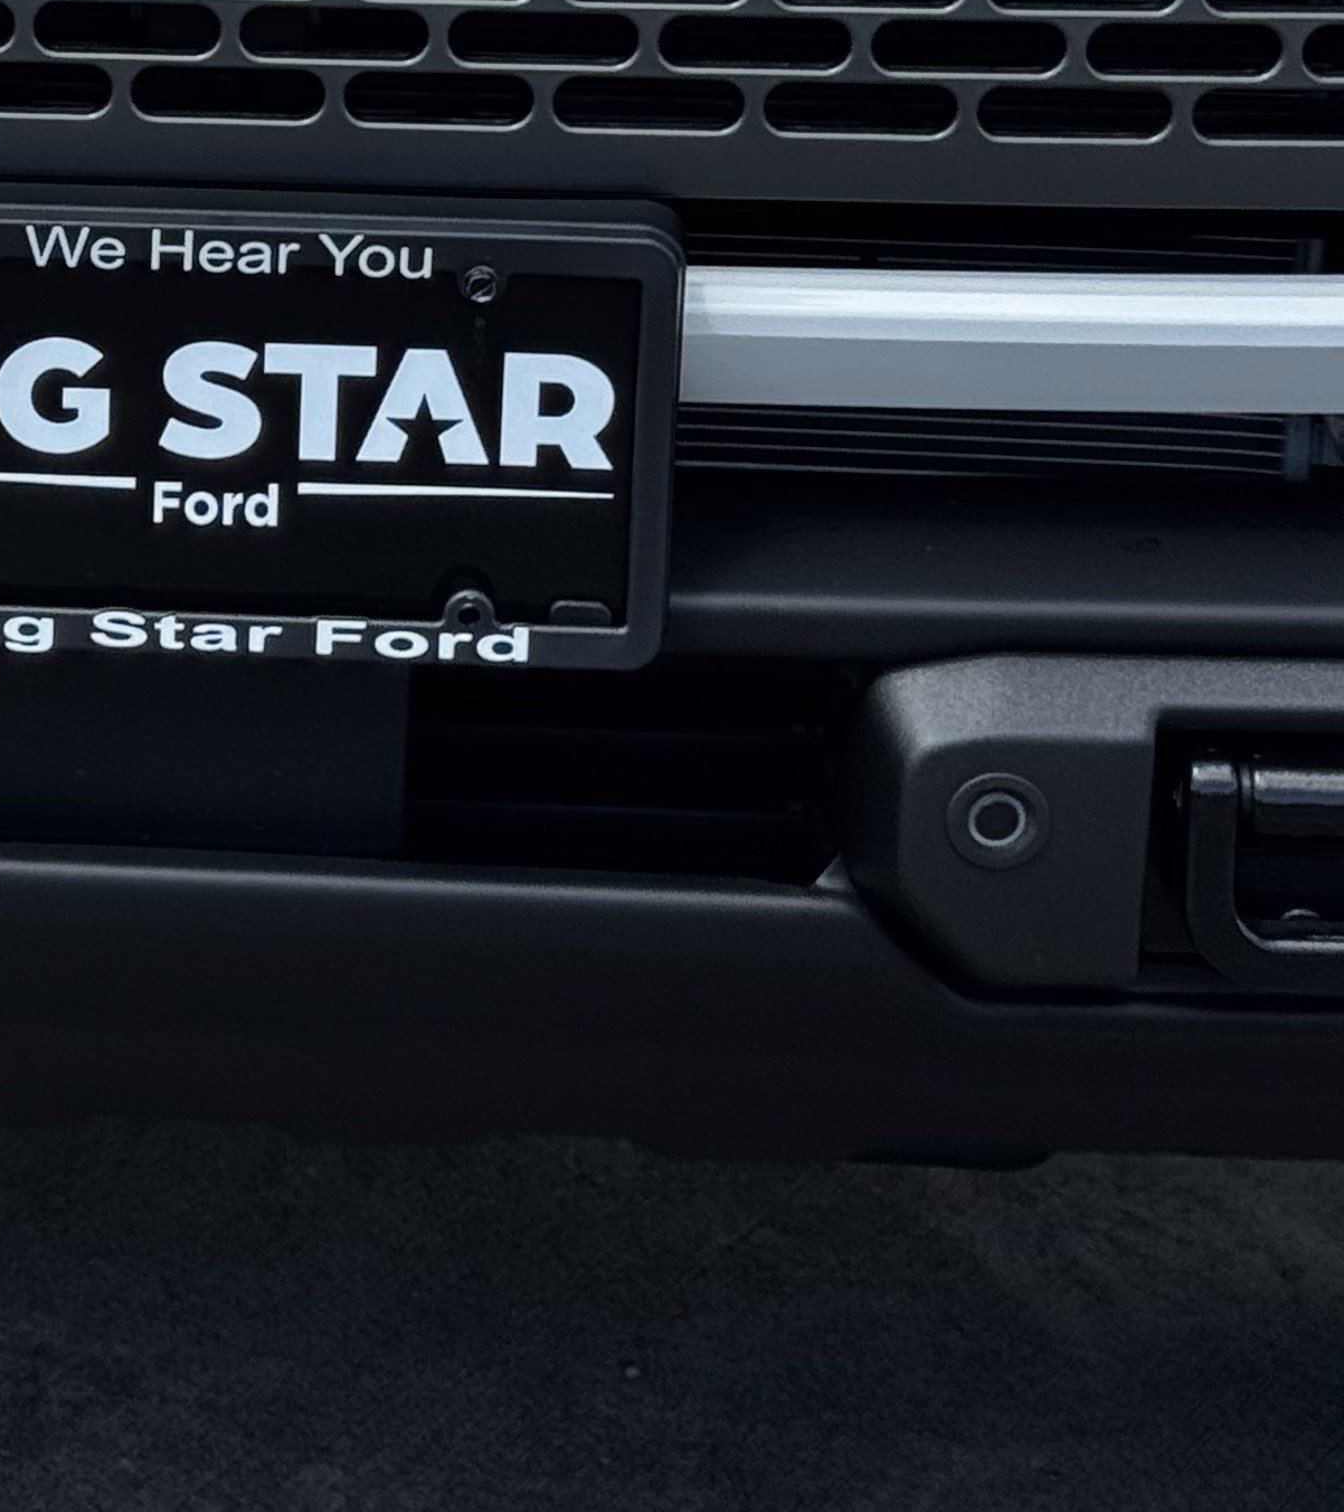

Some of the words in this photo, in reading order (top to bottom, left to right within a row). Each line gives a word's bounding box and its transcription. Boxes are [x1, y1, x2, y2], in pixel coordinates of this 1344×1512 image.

[24, 223, 127, 271] We
[148, 227, 301, 276] Hear
[318, 232, 435, 281] You
[158, 340, 616, 472] STAR
[152, 480, 280, 528] Ford
[89, 609, 283, 655] Star
[314, 619, 531, 664] Ford
